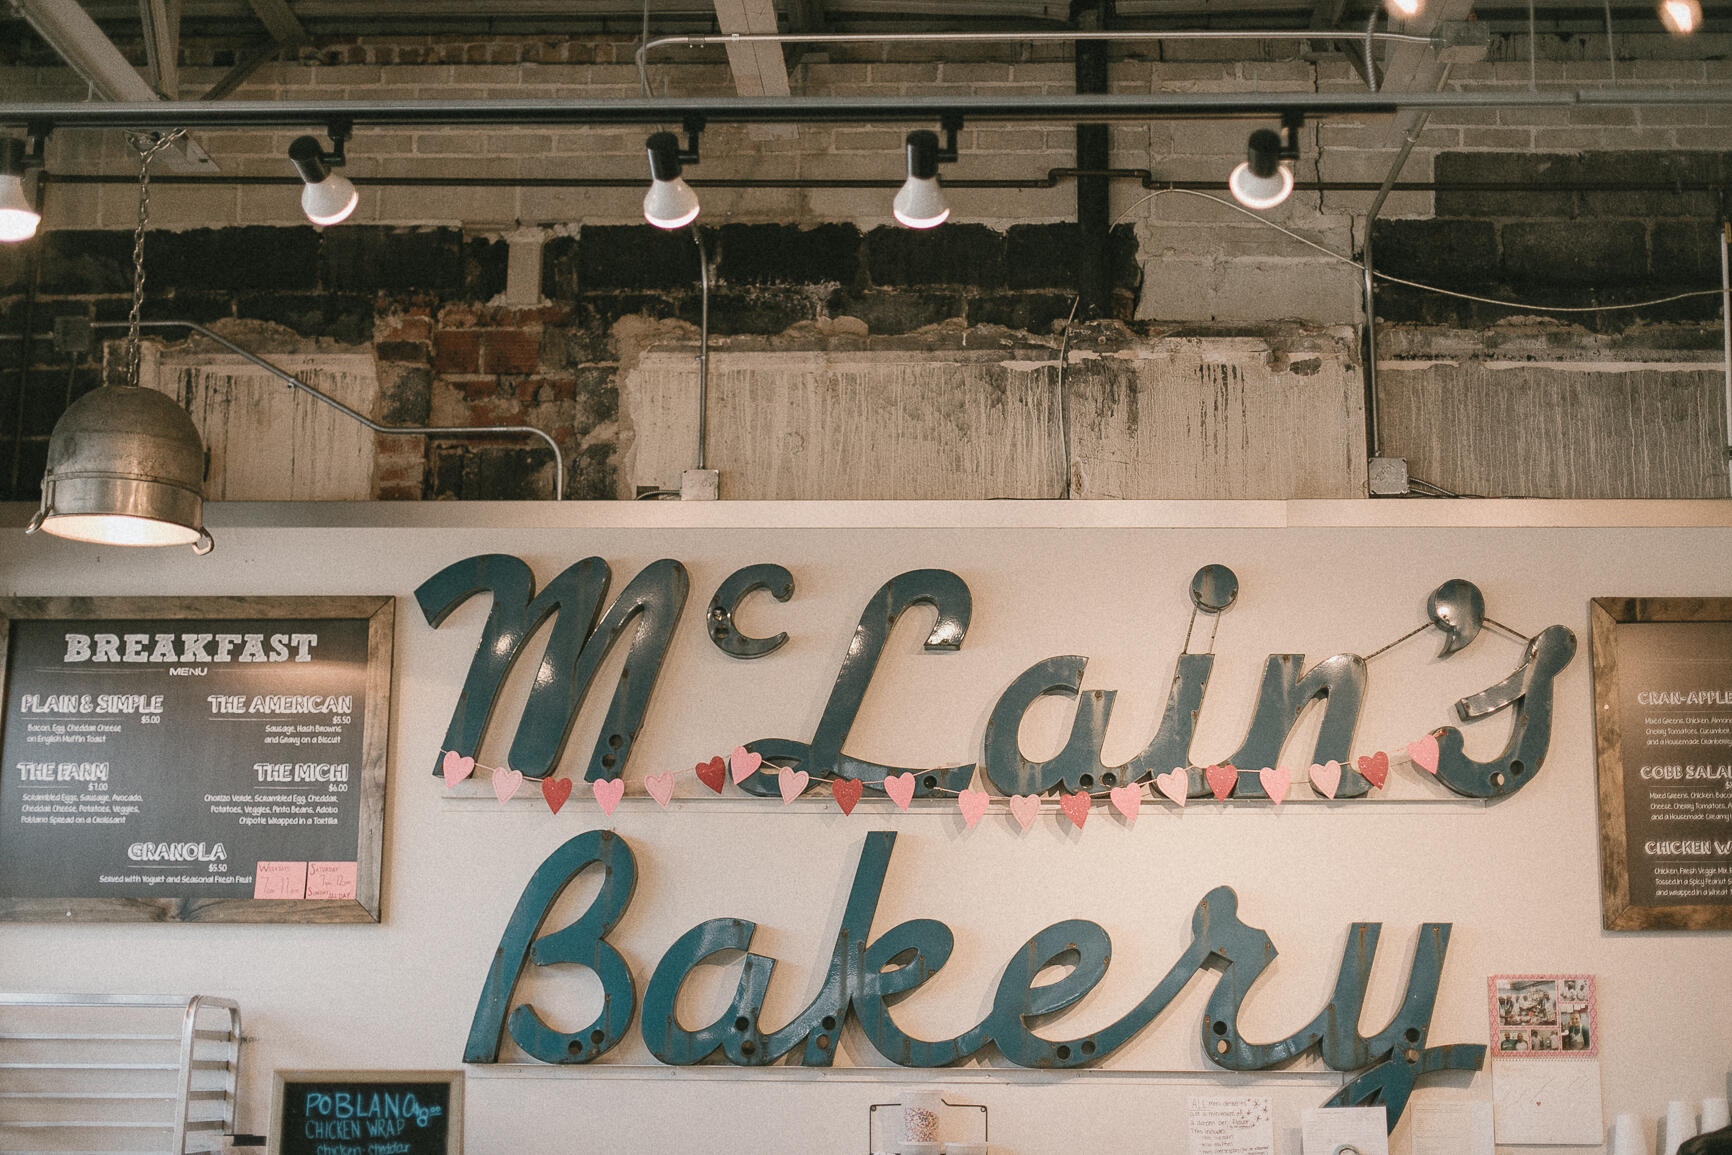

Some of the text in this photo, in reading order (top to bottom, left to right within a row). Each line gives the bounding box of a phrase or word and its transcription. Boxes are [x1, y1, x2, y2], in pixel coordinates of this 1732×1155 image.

[64, 633, 318, 663] BREAKFAST
[169, 667, 208, 676] MENU
[20, 694, 164, 713] PLAIN & SIMPLE
[207, 695, 352, 714] THE AMERICAN
[141, 715, 160, 724] $5.00
[332, 715, 351, 725] $5.50
[297, 724, 314, 733] Hash
[315, 725, 342, 733] Browns
[264, 736, 278, 744] and
[280, 736, 300, 746] Gravy
[318, 736, 341, 744] Biscuit
[16, 762, 109, 781] THE FARM
[253, 763, 292, 782] THE
[1640, 765, 1683, 779] COBB
[328, 784, 348, 793] $6.00
[254, 794, 292, 802] Scrambled
[272, 805, 290, 813] Pinto
[49, 816, 74, 825] Spread
[93, 816, 126, 824] Croissant
[239, 817, 267, 826] Chipotle
[128, 842, 227, 861] GRANOLA
[1645, 841, 1712, 855] CHICKEN
[208, 864, 228, 872] $5.50
[99, 875, 123, 883] Served
[125, 875, 141, 883] with
[142, 875, 165, 885] Yogurt
[181, 875, 214, 883] Seasonal
[215, 875, 235, 883] Fresh
[236, 875, 253, 883] Fruit
[462, 829, 1486, 1136] Bakery
[305, 1092, 416, 1118] POBLANO
[305, 1118, 405, 1139] CHICKEN WRAP
